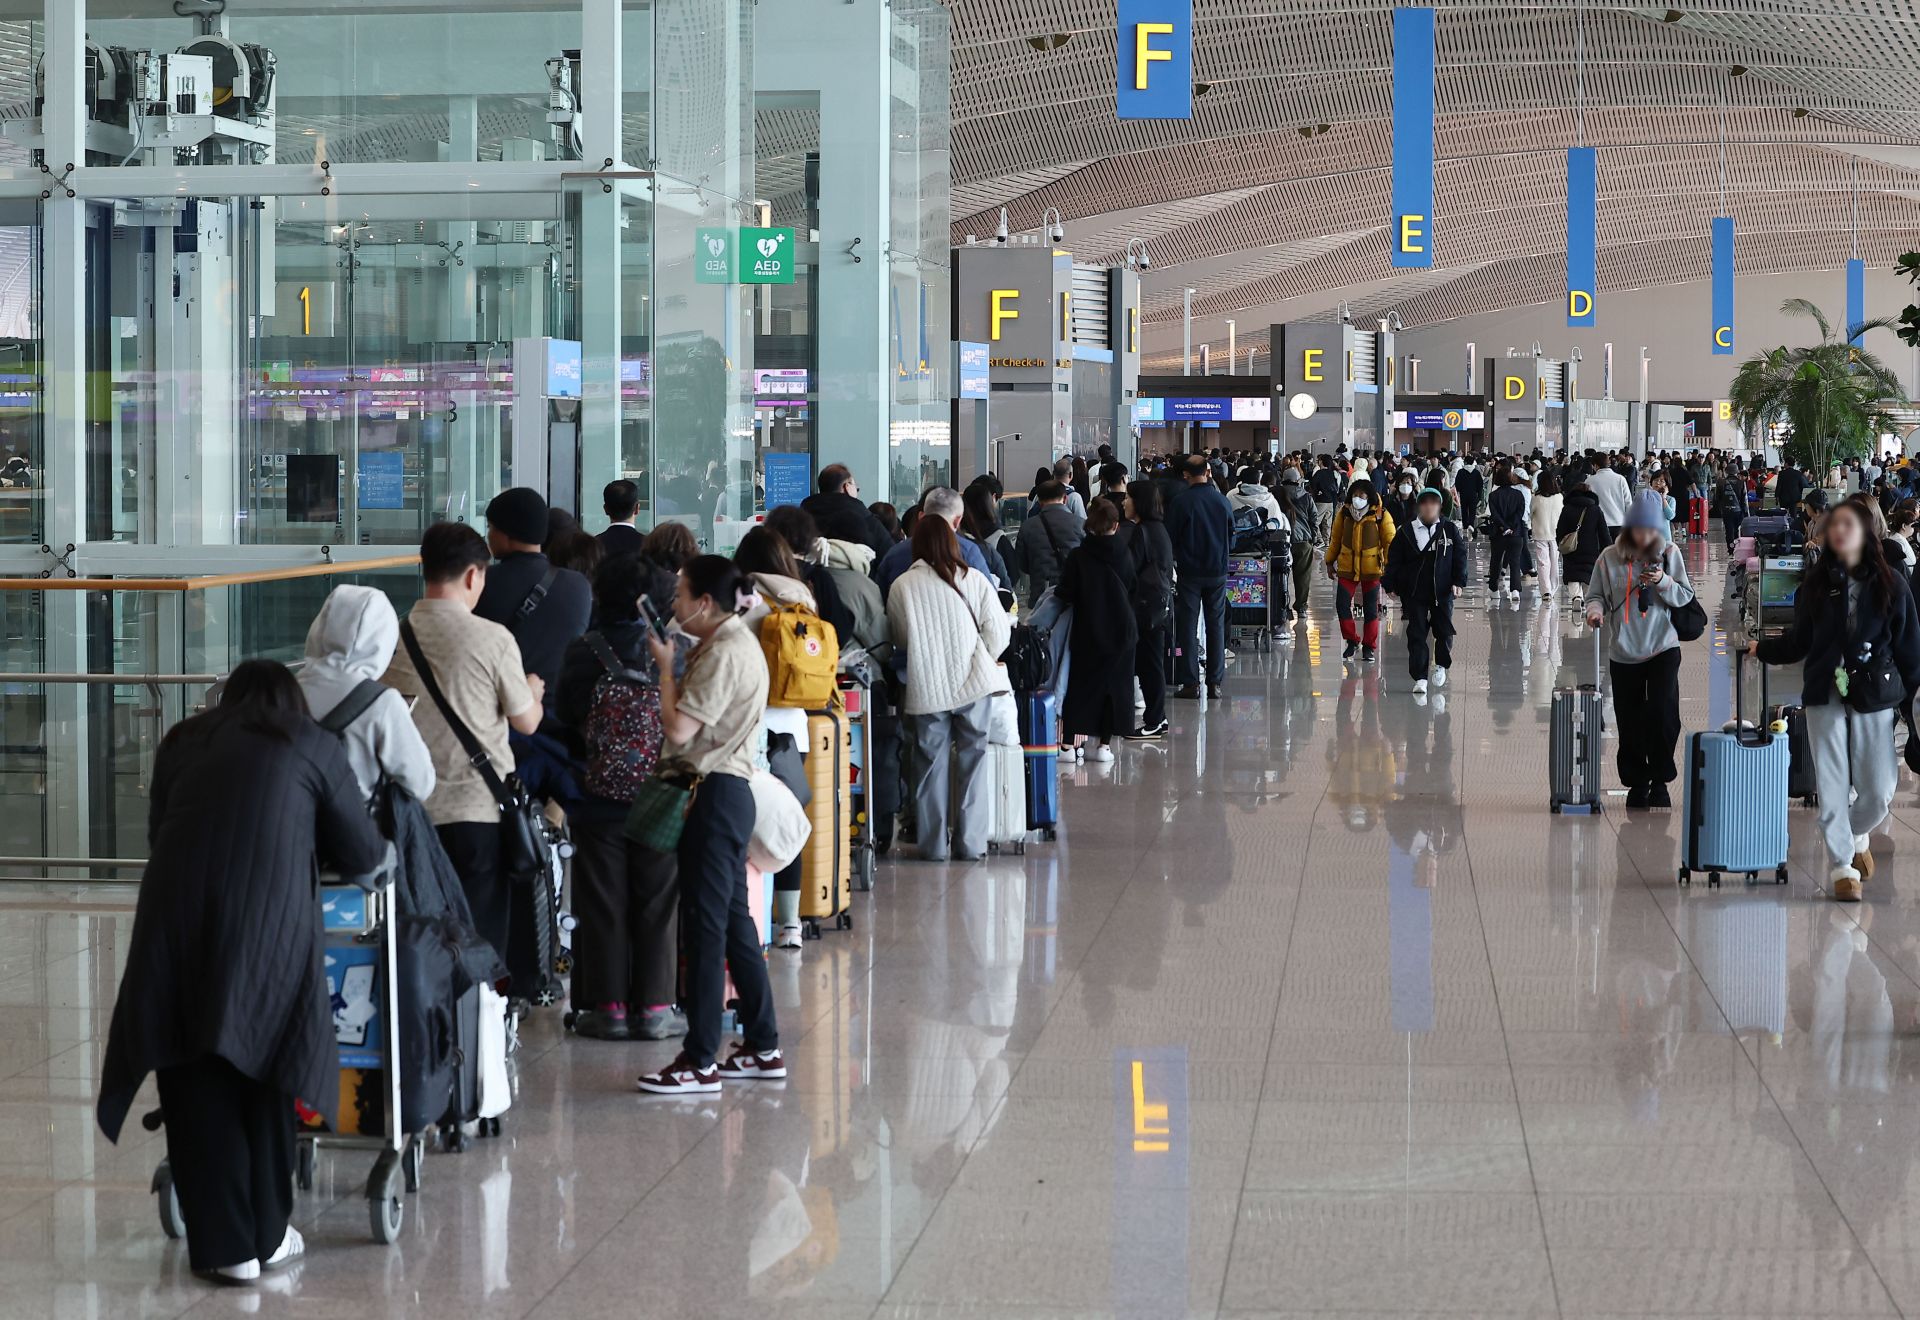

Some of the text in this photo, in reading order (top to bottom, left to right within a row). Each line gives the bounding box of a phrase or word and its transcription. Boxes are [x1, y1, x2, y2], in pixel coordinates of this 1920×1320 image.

[1136, 23, 1173, 89] F
[1401, 215, 1424, 253] E
[754, 260, 781, 271] AED
[991, 289, 1019, 341] F
[1570, 290, 1593, 317] D
[1715, 326, 1731, 347] C
[1002, 357, 1047, 367] Check-In
[1304, 349, 1323, 382] E
[1504, 376, 1526, 400] D
[1719, 402, 1732, 420] B
